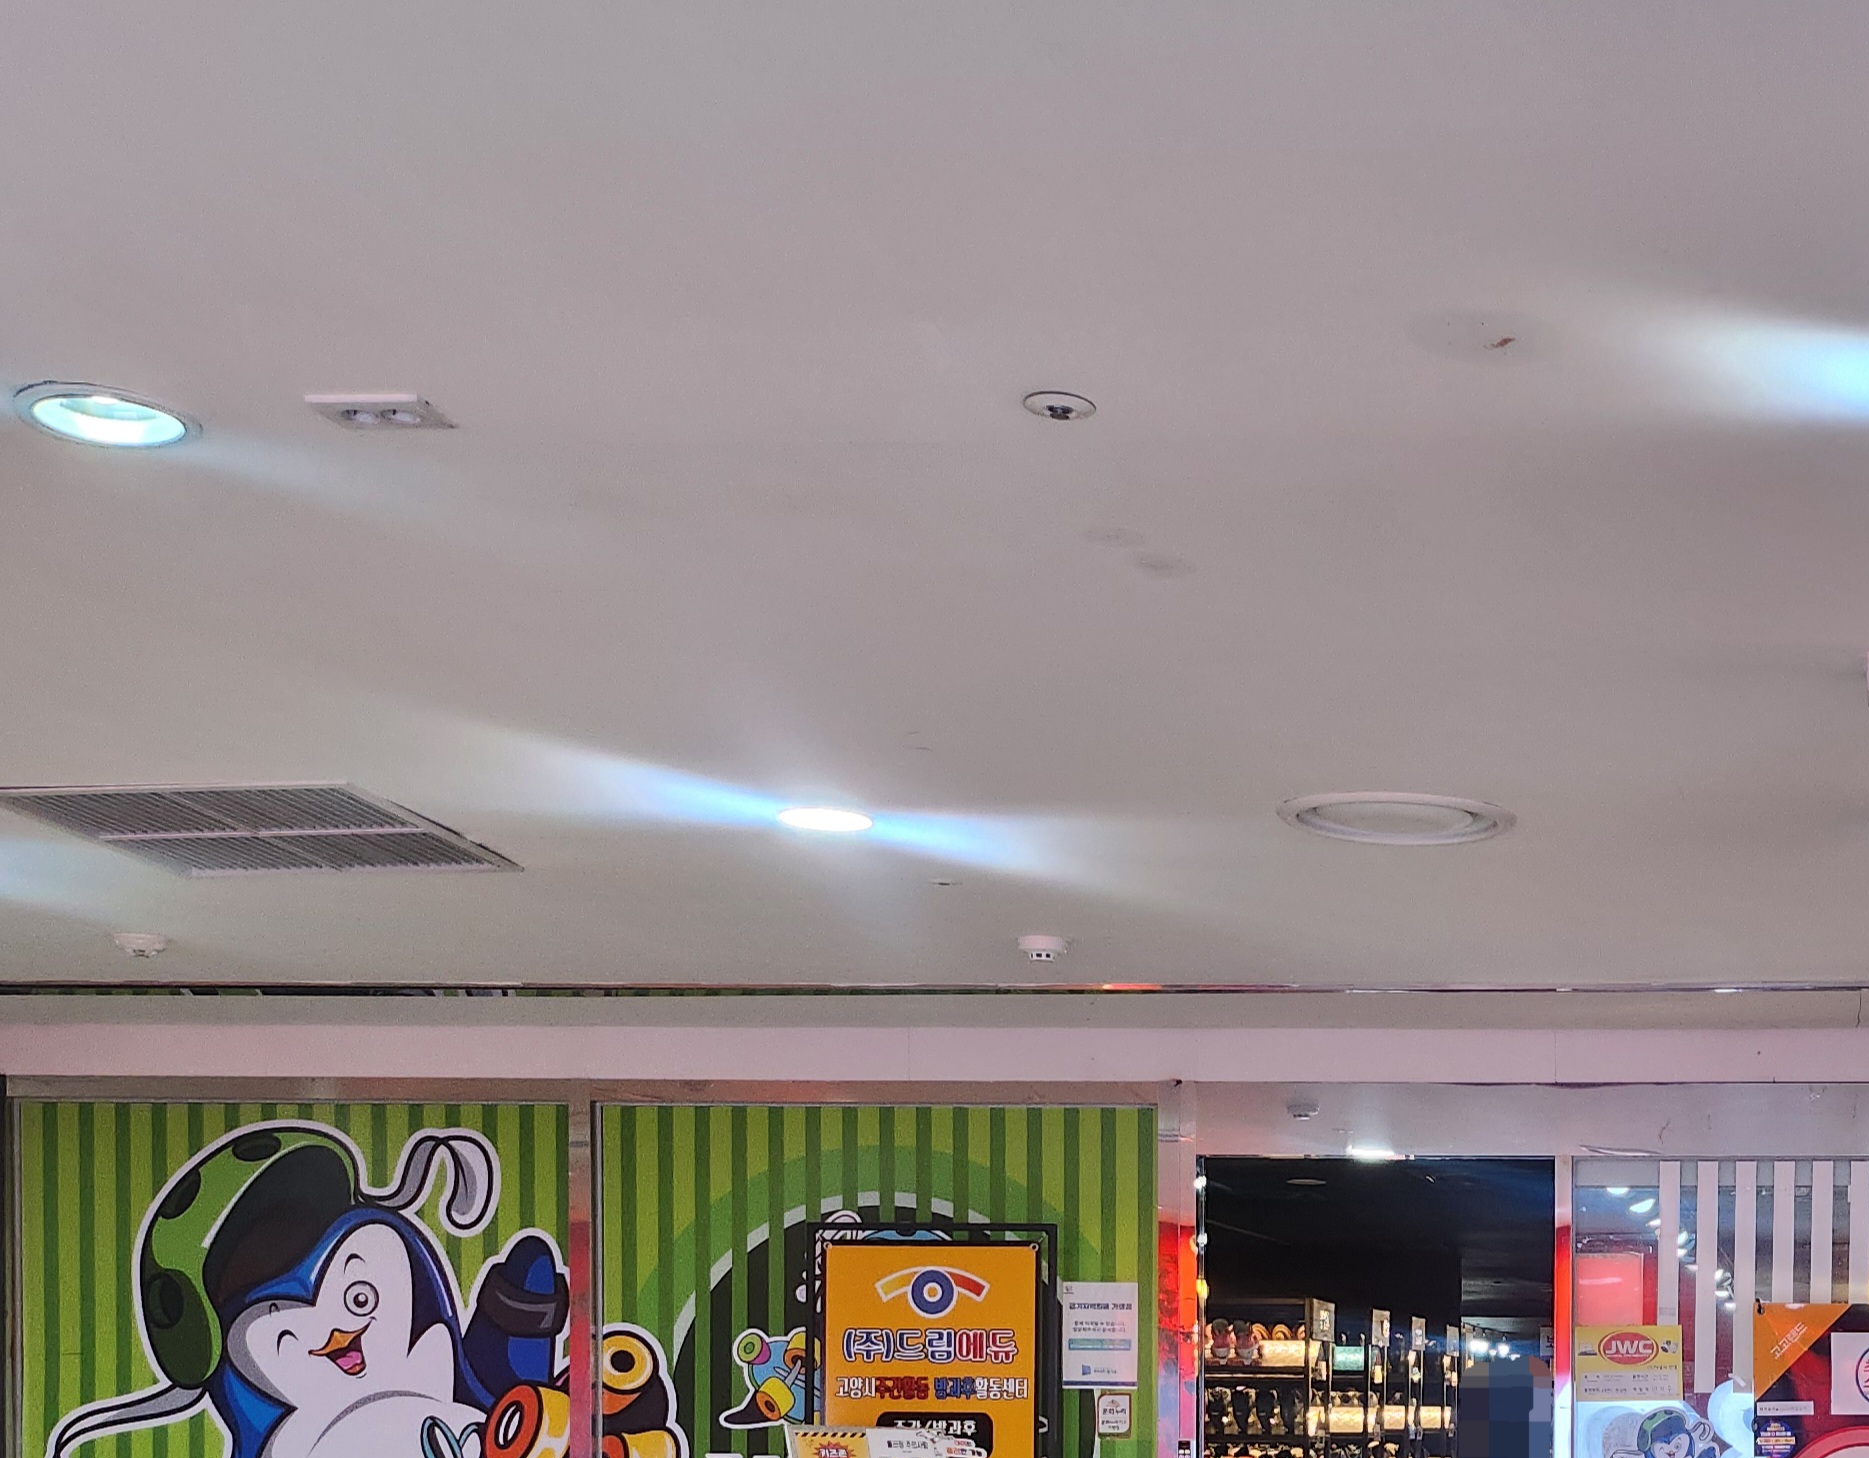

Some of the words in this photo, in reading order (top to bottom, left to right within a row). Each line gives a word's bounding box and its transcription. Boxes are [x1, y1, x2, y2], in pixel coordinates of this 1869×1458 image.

[842, 1328, 1019, 1363] (주)드림에듀
[1604, 1339, 1654, 1355] JWC
[933, 1376, 1029, 1400] 방과후활동센터
